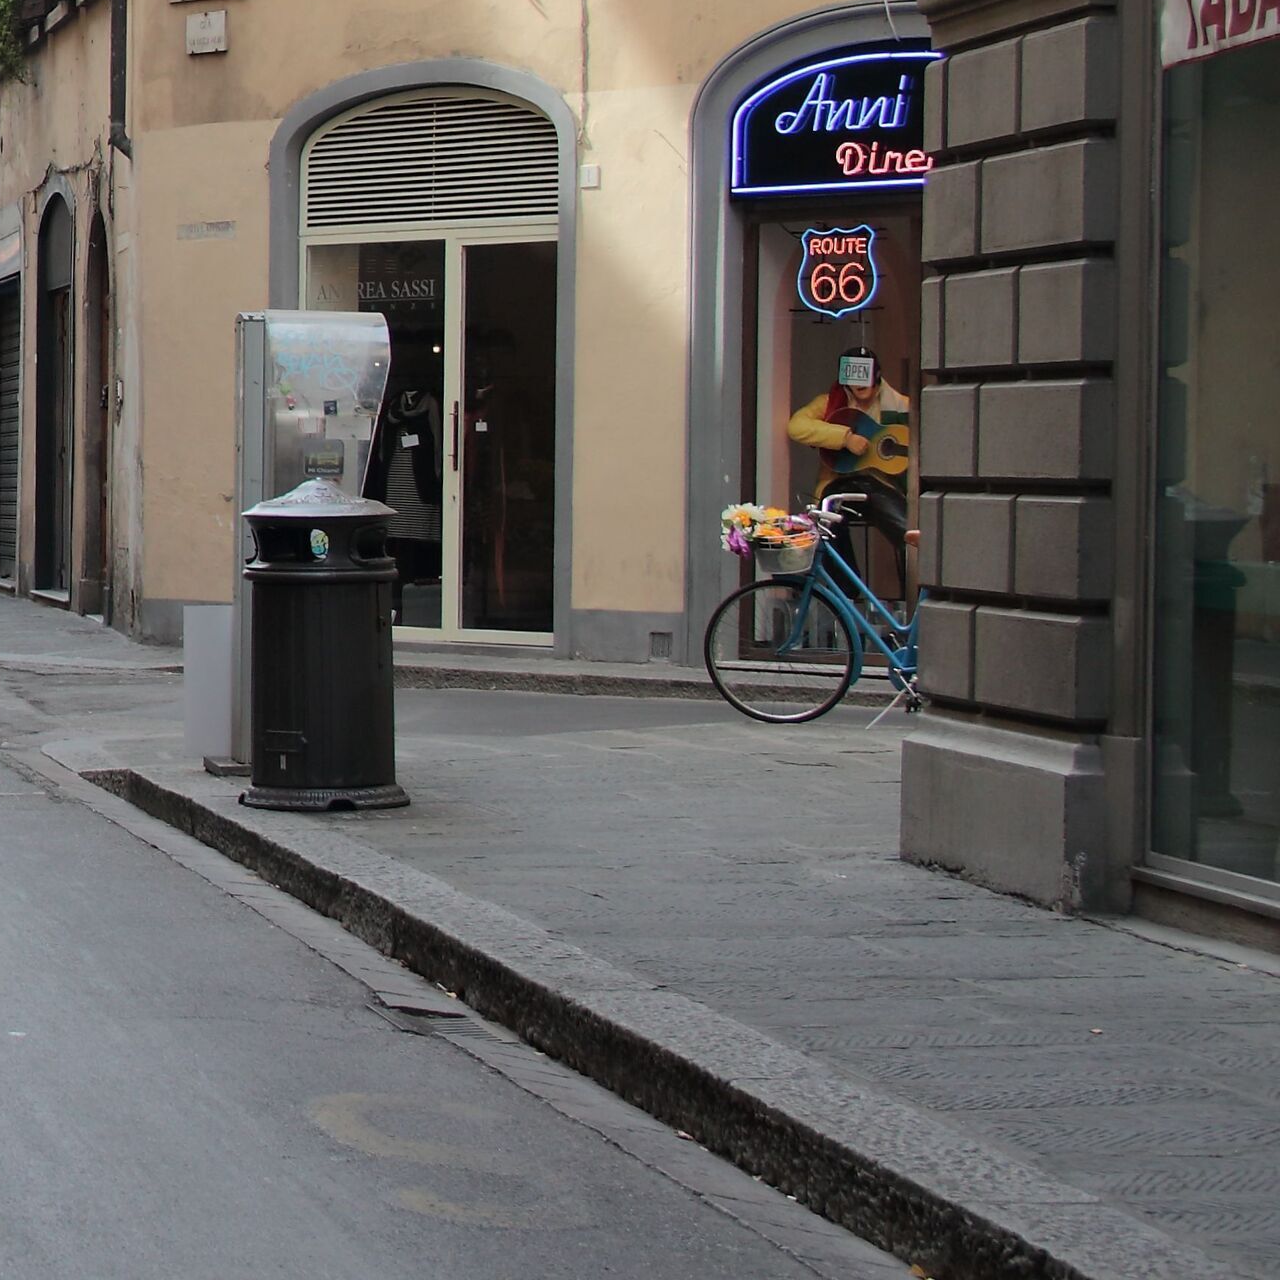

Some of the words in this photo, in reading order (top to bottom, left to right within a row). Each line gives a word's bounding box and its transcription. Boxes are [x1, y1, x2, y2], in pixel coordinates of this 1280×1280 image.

[836, 141, 933, 176] Dine
[809, 237, 867, 256] ROUTE
[317, 281, 387, 301] ANREA
[391, 279, 435, 298] SASSI
[811, 262, 865, 303] 66
[845, 364, 870, 379] OPEN
